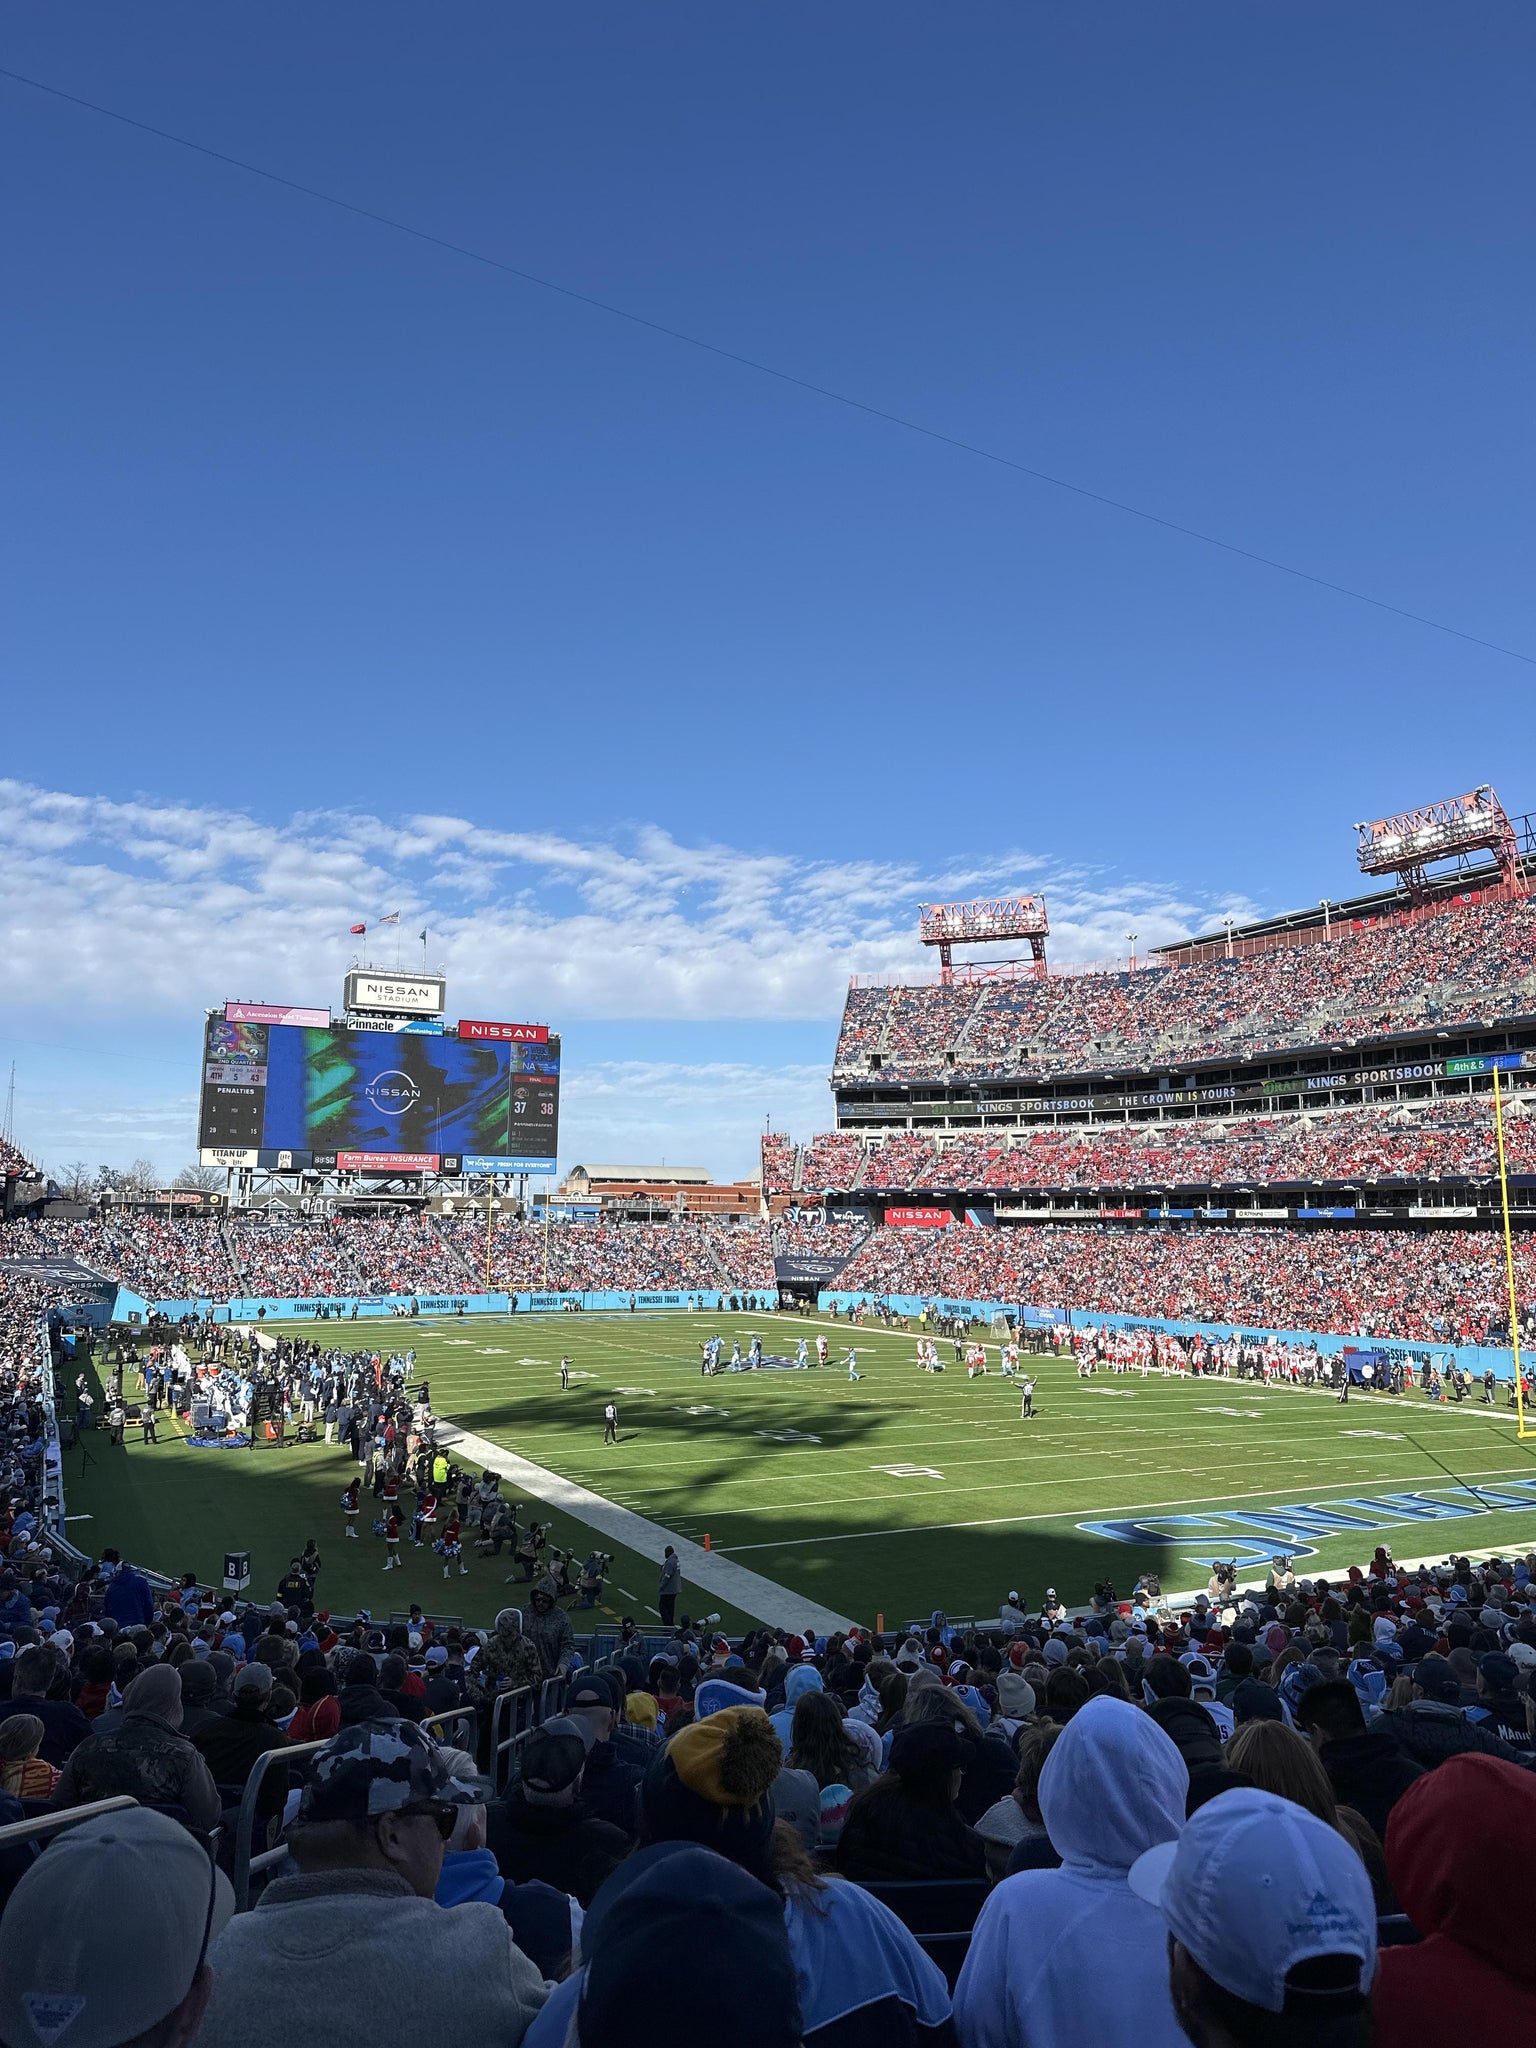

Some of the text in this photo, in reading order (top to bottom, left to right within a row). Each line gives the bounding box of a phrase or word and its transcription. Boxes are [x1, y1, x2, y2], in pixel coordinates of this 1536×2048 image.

[368, 984, 429, 997] NISSAN
[377, 995, 418, 1003] STADIUM
[246, 1010, 277, 1019] Ascension
[348, 1018, 394, 1032] Pinnacle
[471, 1025, 537, 1039] NISSAN
[1453, 1060, 1485, 1072] 4th & 5
[210, 1072, 223, 1080] 4TH
[250, 1074, 260, 1082] 43
[1261, 1063, 1444, 1095] DRAFTKINGS SPORTSBOOK
[217, 1087, 255, 1095] PENALTIES
[365, 1088, 421, 1098] NISSAN
[1118, 1087, 1236, 1106] THE CROWN IS YOURS
[514, 1101, 527, 1114] 37
[540, 1102, 554, 1115] 38
[931, 1098, 1095, 1115] DRAFTKINGS SPORTSBOOK
[212, 1149, 248, 1158] TITAN UP
[343, 1154, 434, 1163] Farm Bureau INSURANCE
[497, 1160, 512, 1168] FRESH
[842, 1210, 866, 1223] Kroger
[420, 1300, 449, 1309] TENNESSEE
[531, 1298, 558, 1306] TENNESSEE
[638, 1296, 680, 1304] TENNESSEE TOUGH
[294, 1303, 346, 1312] TENNESEE TOUH
[867, 1462, 944, 1478] 10
[228, 1562, 236, 1577] B
[242, 1560, 248, 1576] B
